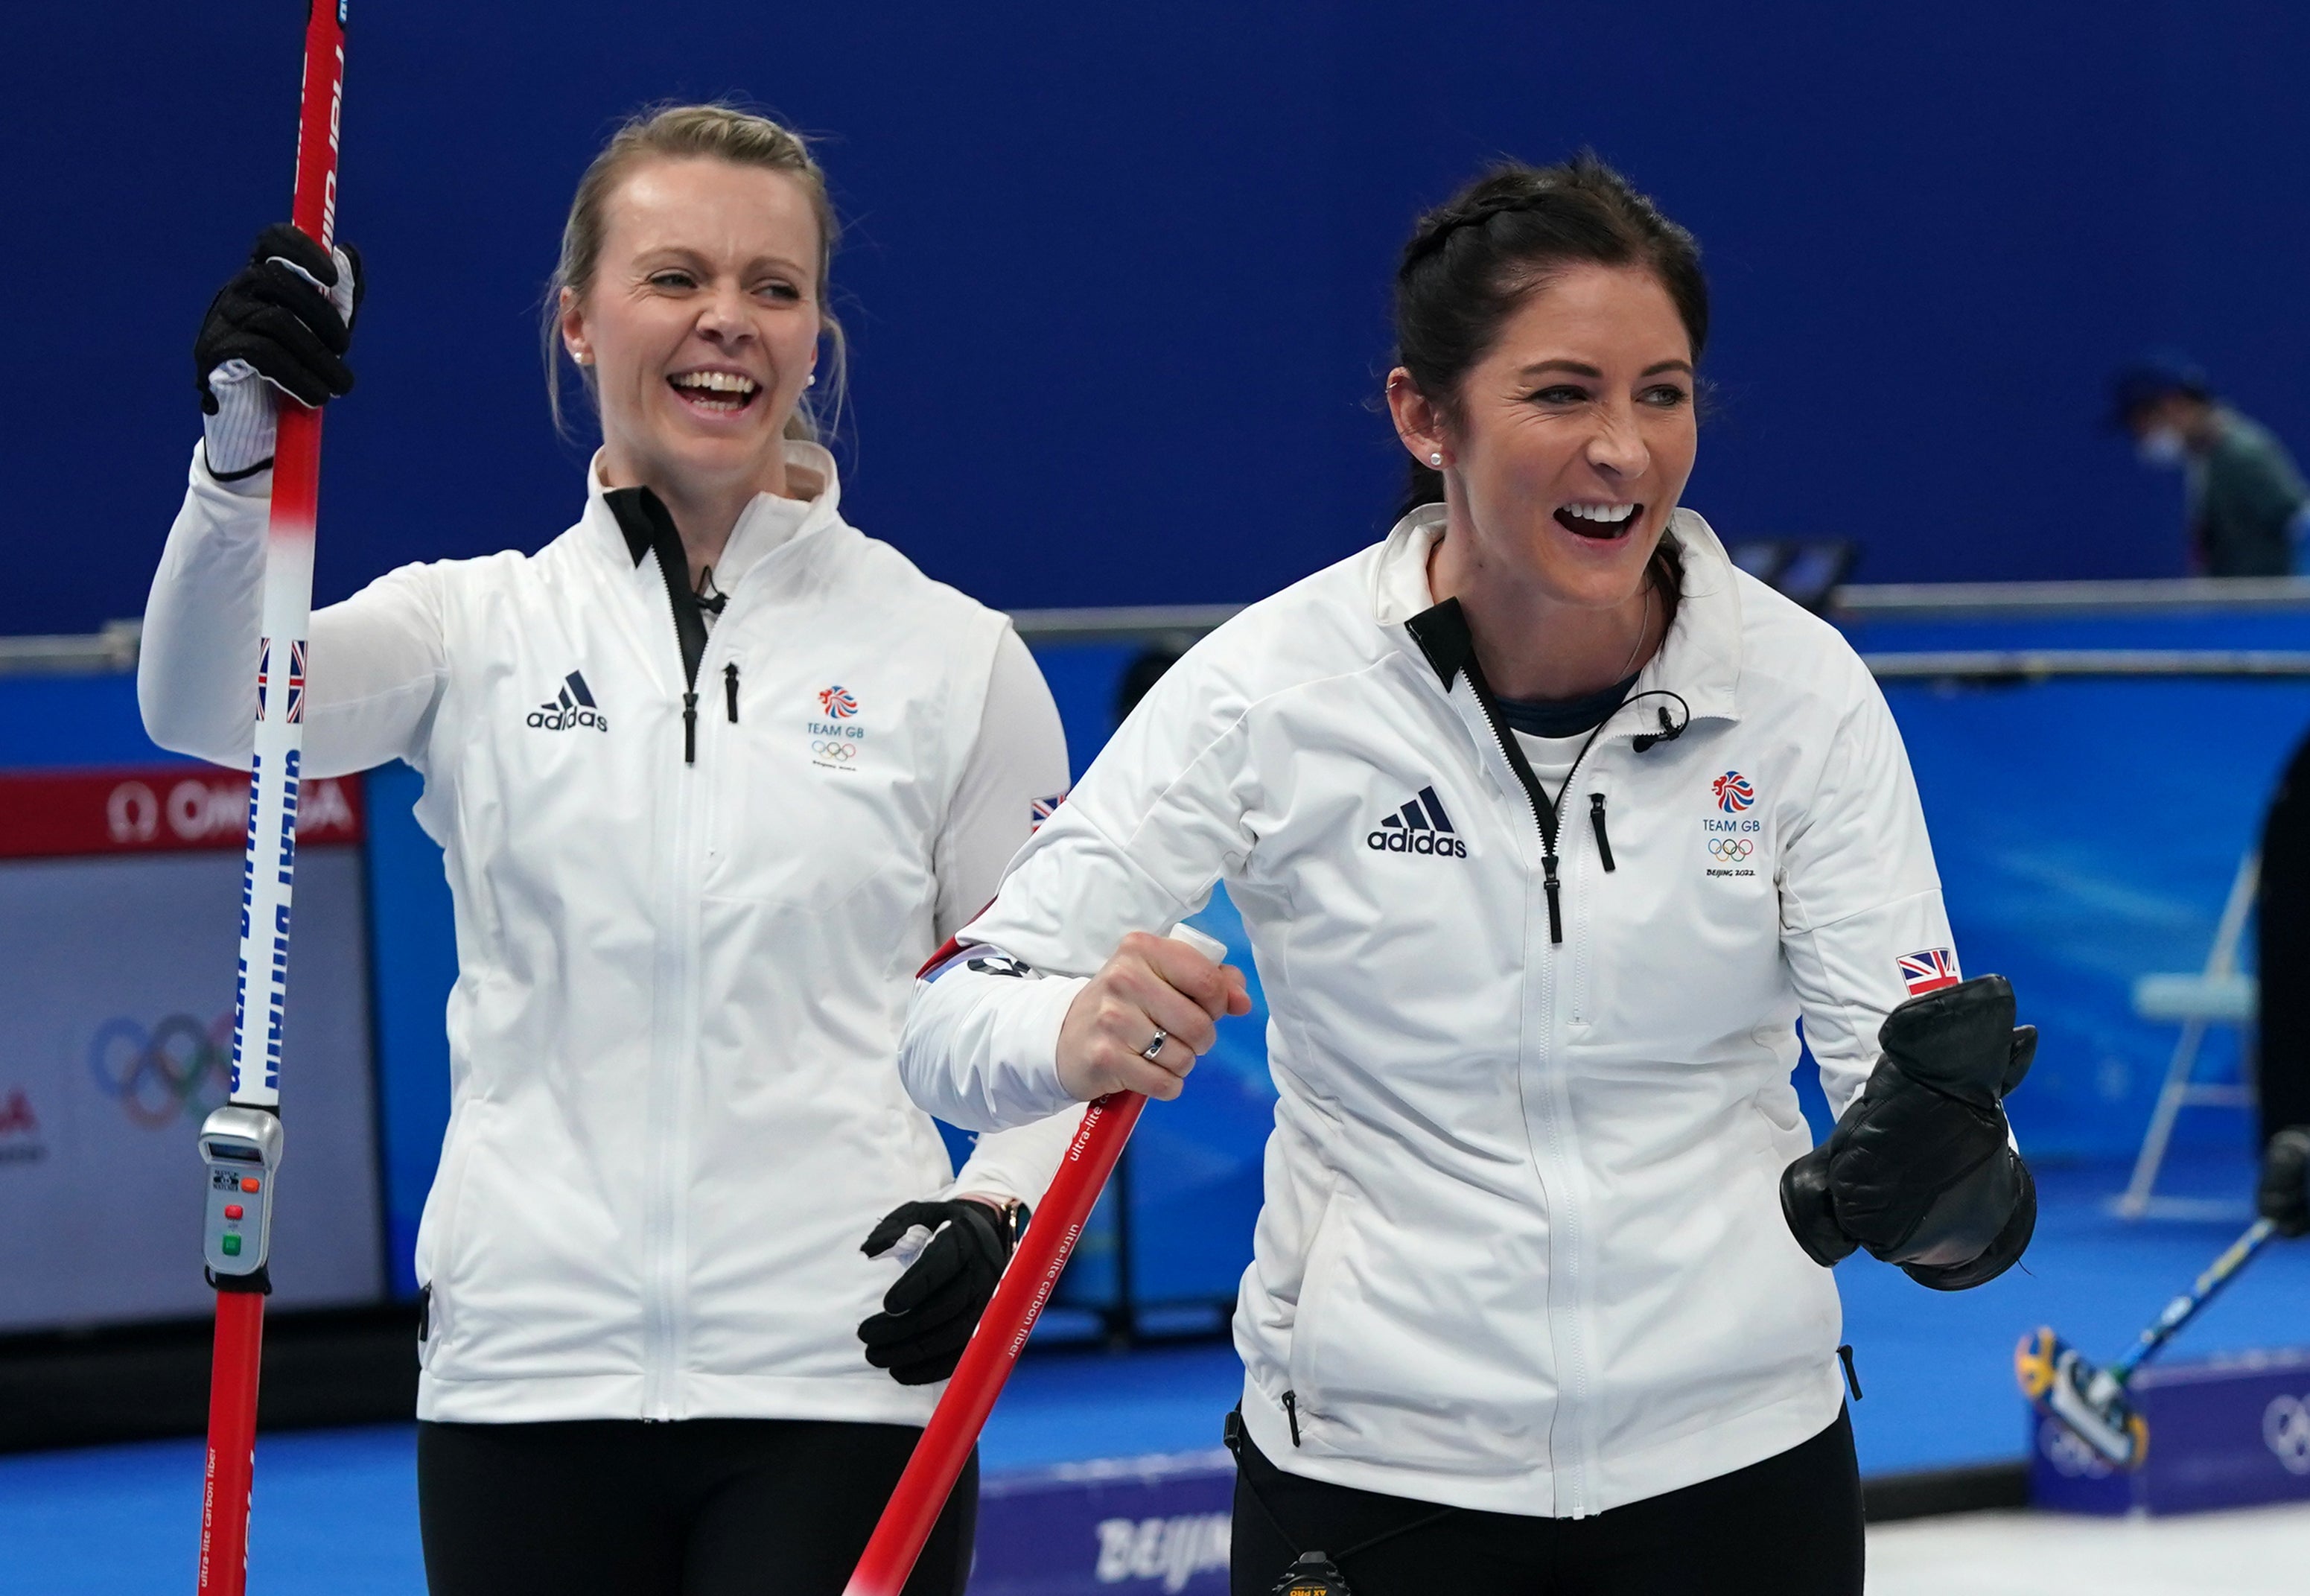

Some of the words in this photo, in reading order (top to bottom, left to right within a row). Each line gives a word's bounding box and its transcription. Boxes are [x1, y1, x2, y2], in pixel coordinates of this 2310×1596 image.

[526, 705, 608, 732] adidas
[808, 722, 842, 737] TEAM
[845, 726, 864, 739] GB
[1703, 819, 1737, 832] TEAM
[1741, 820, 1760, 832] GB
[1367, 827, 1467, 859] adidas
[1706, 868, 1733, 878] BEIJING
[1069, 1106, 1102, 1162] ultra-lite
[1046, 1224, 1079, 1279] ultra-lite
[1023, 1281, 1050, 1326] carbon
[1008, 1328, 1028, 1359] fiber
[207, 1446, 216, 1478] fiber
[204, 1481, 214, 1527] carbon
[200, 1530, 211, 1588] ultra-lite
